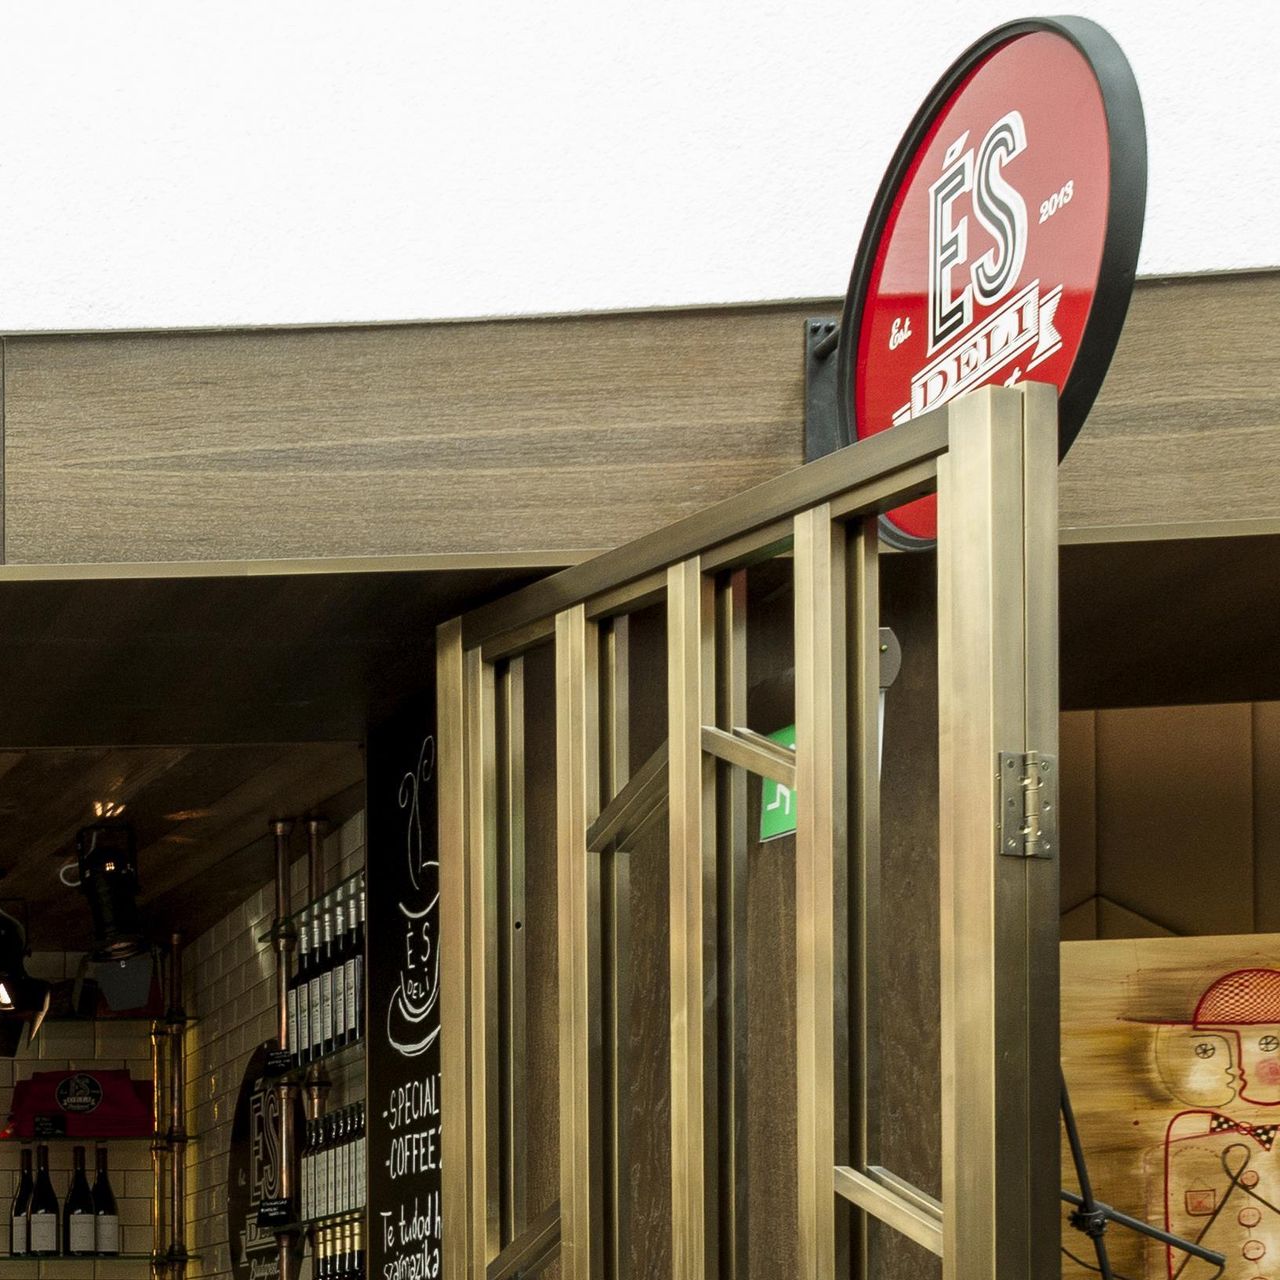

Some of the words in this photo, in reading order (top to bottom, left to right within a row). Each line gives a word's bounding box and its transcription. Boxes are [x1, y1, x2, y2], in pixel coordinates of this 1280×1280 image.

[1039, 179, 1074, 225] 2013
[927, 109, 1028, 358] ÉS
[888, 317, 911, 350] Est.
[916, 300, 1032, 412] DELI
[407, 922, 430, 969] ÉS
[380, 1211, 394, 1253] Te
[399, 1193, 431, 1245] tudod
